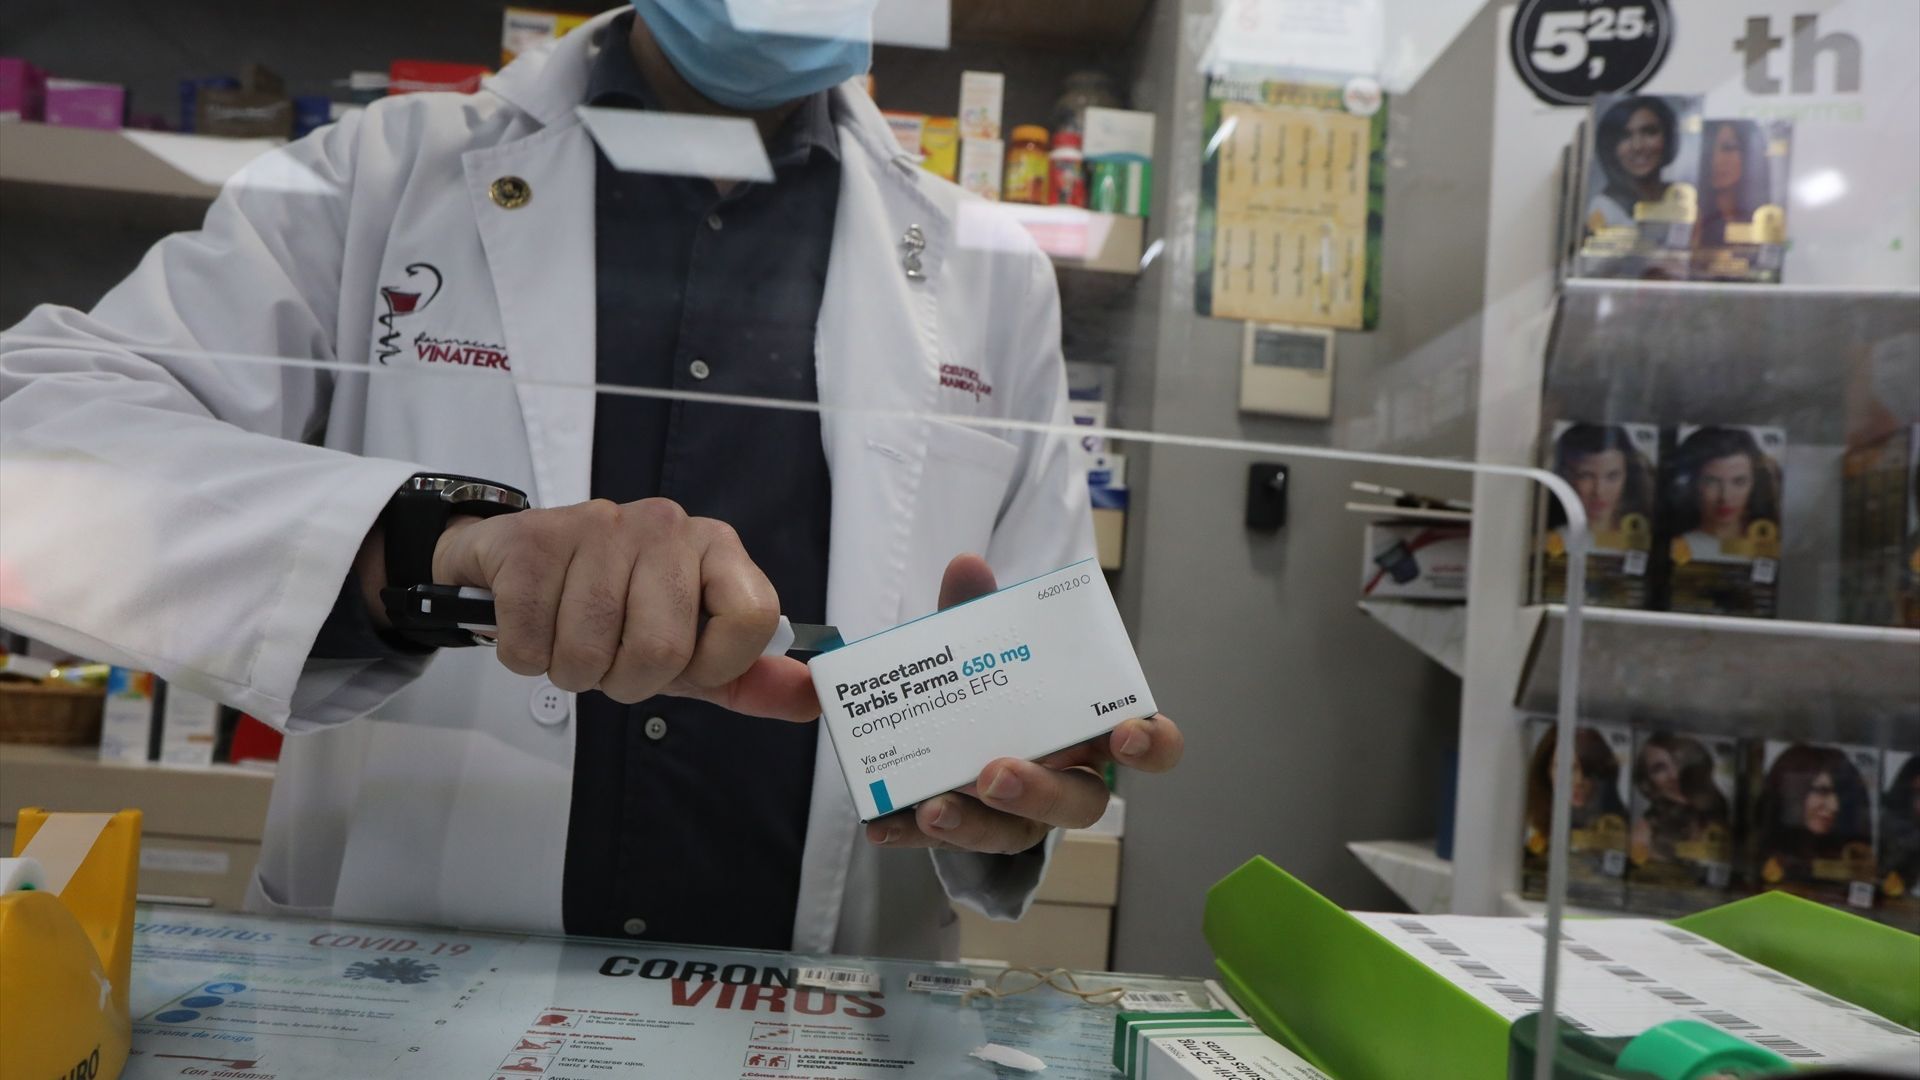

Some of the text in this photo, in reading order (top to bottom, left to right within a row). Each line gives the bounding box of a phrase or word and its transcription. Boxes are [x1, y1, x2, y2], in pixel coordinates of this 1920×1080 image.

[1733, 13, 1863, 95] th
[835, 645, 954, 701] Paracetamol
[843, 644, 1031, 719] Tarbis Farma 650 mg
[852, 669, 1009, 738] comprimidos EFG
[861, 746, 897, 766] Vía oral
[865, 747, 931, 775] 40 comprimidos
[309, 932, 472, 956] COVID-19
[598, 956, 799, 989] CORON
[671, 977, 886, 1018] VIRUS
[191, 1030, 210, 1039] de
[212, 1032, 254, 1042] riesgo
[1177, 1038, 1201, 1051] mg
[589, 1057, 622, 1066] tocarse
[818, 1055, 868, 1063] PERSONAS
[1190, 1051, 1220, 1065] 575
[1202, 1040, 1237, 1061] duras
